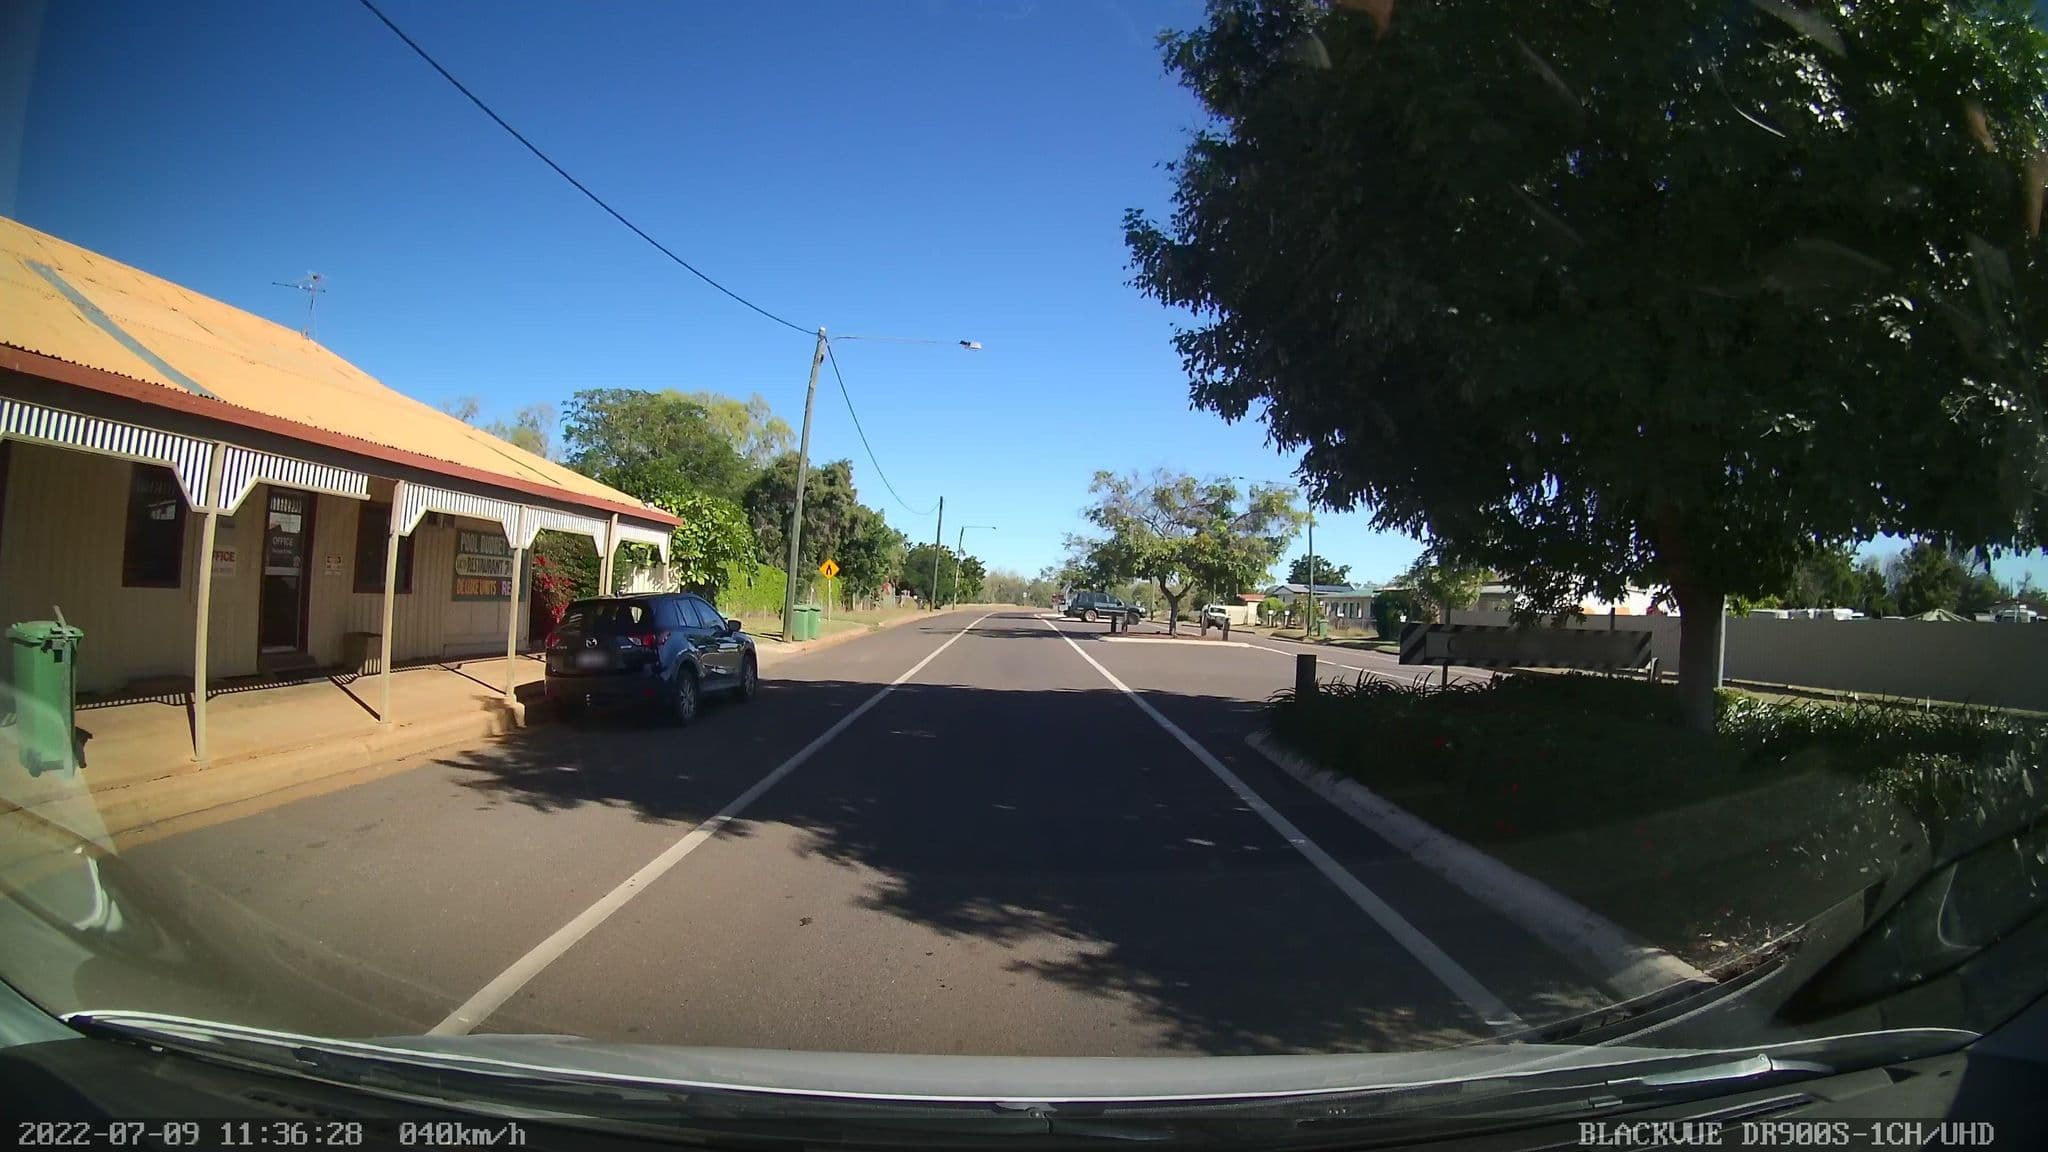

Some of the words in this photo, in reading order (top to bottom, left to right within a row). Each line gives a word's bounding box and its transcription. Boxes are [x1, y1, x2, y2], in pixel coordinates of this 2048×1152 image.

[272, 536, 294, 547] OFFICE
[461, 532, 478, 553] POOL
[481, 535, 506, 556] BUDGET
[212, 550, 236, 562] FFICE
[467, 557, 503, 575] RESTAURANT
[480, 580, 496, 595] UNITS
